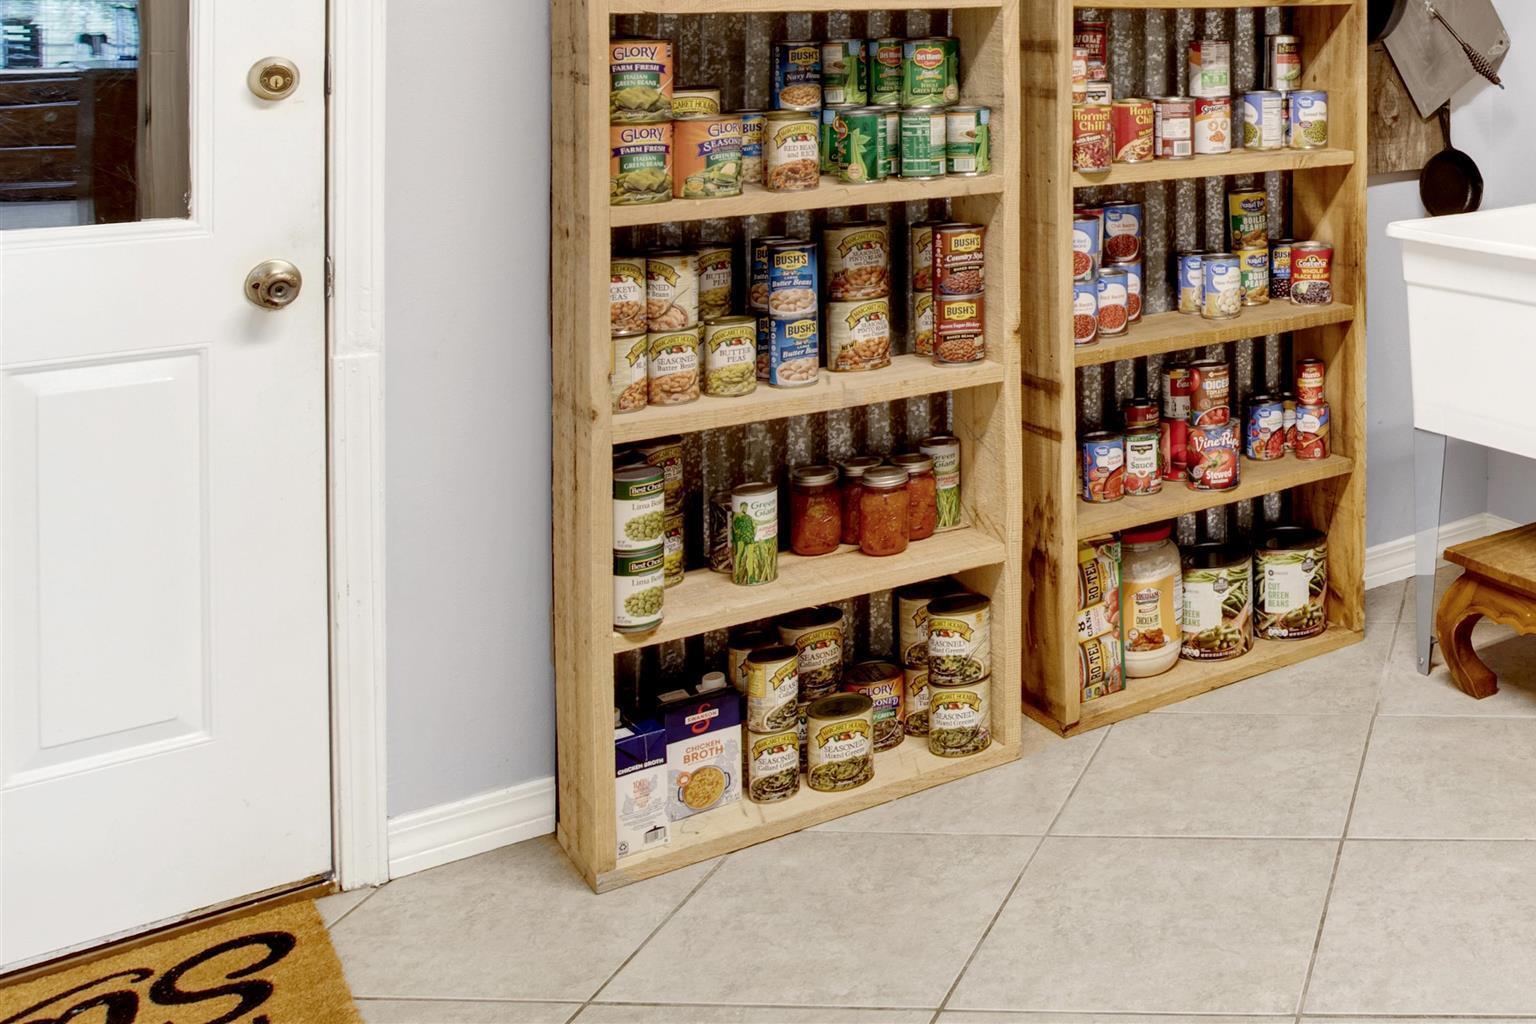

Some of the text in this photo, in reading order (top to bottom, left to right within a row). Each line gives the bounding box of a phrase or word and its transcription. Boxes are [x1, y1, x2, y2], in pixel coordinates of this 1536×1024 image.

[612, 47, 658, 61] GLORY
[790, 51, 819, 63] BUSH'S
[612, 64, 633, 72] FARM
[1074, 111, 1110, 120] Hormel
[1079, 121, 1105, 131] Chili
[621, 128, 664, 143] GLORY
[644, 145, 665, 153] FRESH
[953, 237, 980, 247] BUSH'S
[775, 251, 808, 266] BUSH'S
[946, 307, 975, 316] BUSH'S
[788, 322, 816, 336] BUSH'S
[657, 355, 696, 365] SEASONED
[727, 354, 747, 363] PEAS
[1130, 461, 1154, 469] Sauce
[1206, 470, 1232, 481] Stewed
[632, 486, 646, 495] Best
[632, 502, 649, 511] Lima
[750, 498, 776, 510] Green
[755, 509, 776, 517] Giant
[631, 562, 646, 571] Best
[631, 578, 649, 587] Lima
[800, 647, 839, 661] SEASONED
[687, 710, 717, 723] SWANSON
[685, 739, 721, 754] CHICKEN
[823, 738, 865, 753] SEASONED
[683, 746, 724, 764] BROTH
[617, 758, 664, 776] CHICKEN BROTH
